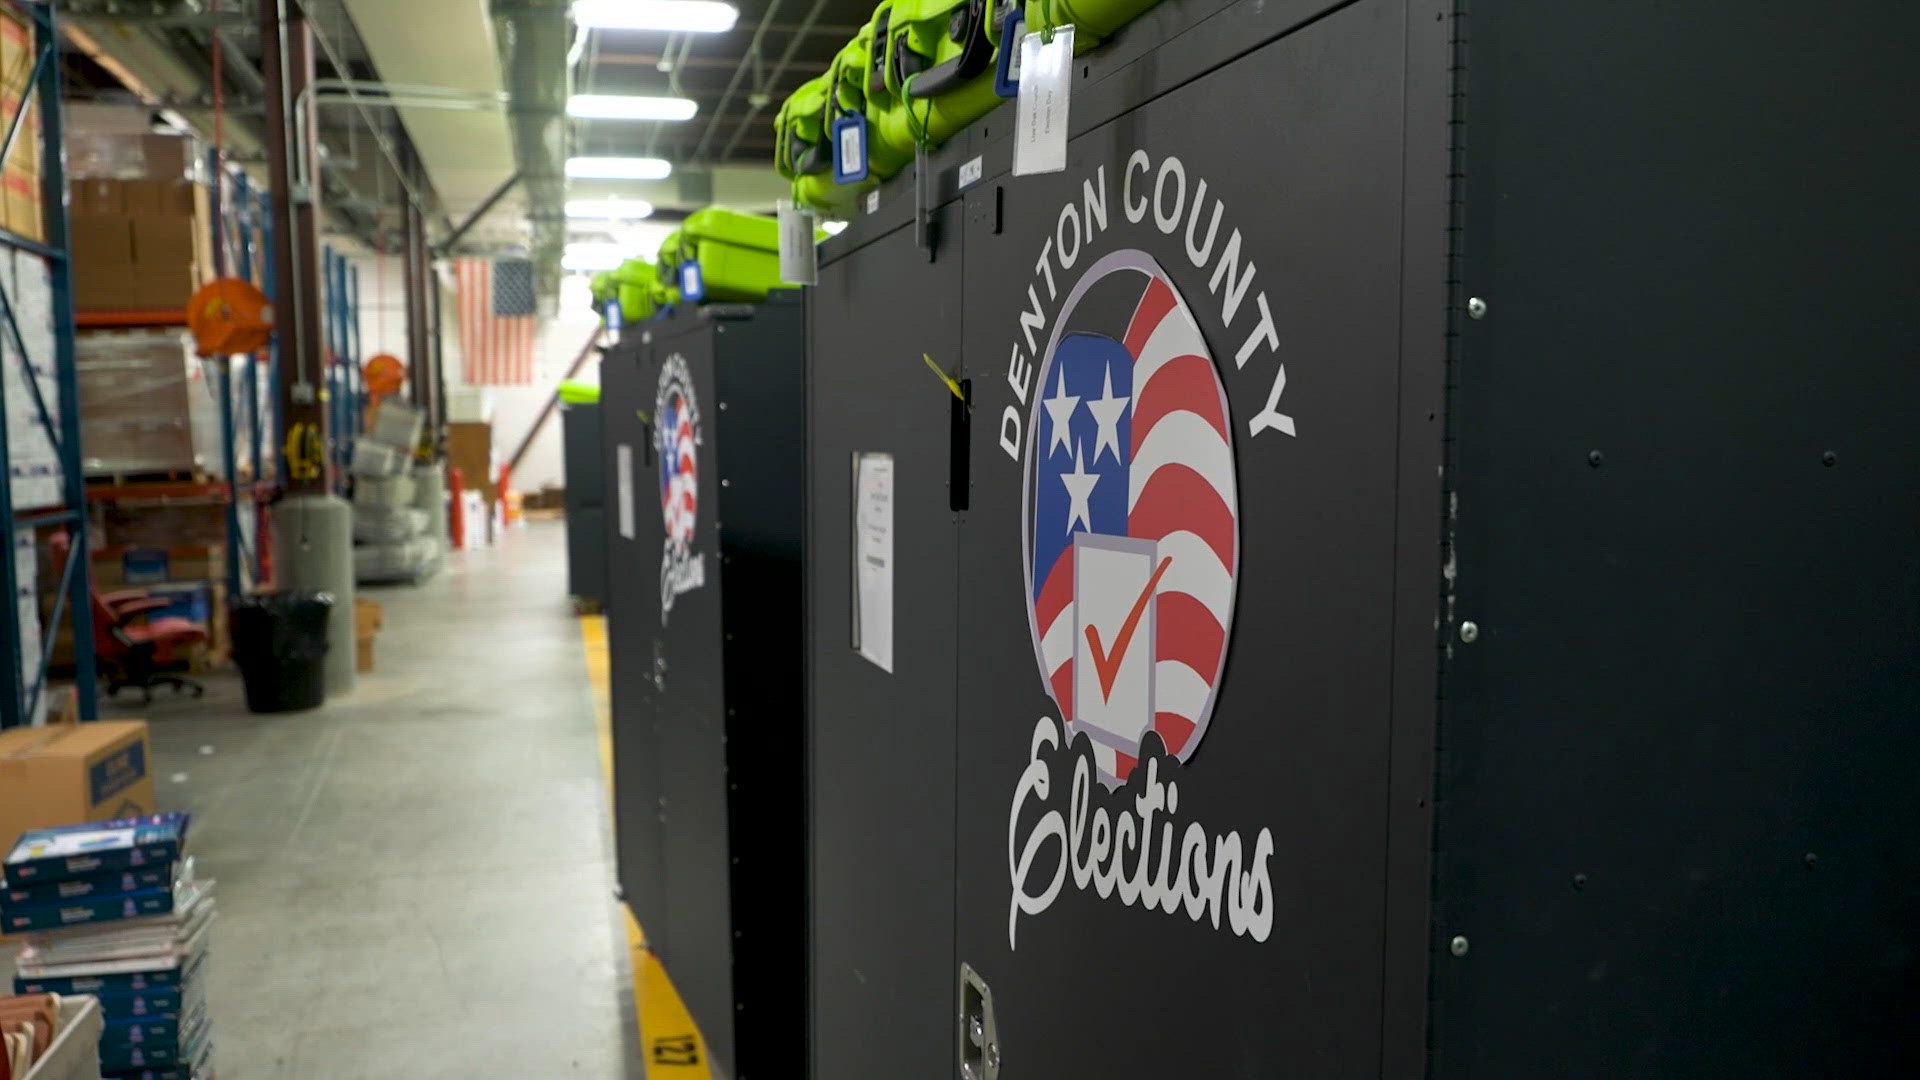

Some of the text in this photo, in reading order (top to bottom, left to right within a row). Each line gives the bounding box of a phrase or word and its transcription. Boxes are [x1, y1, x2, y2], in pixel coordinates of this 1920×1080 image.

[1000, 150, 1296, 462] DENTON COUNTY
[1009, 716, 1274, 951] Elections
